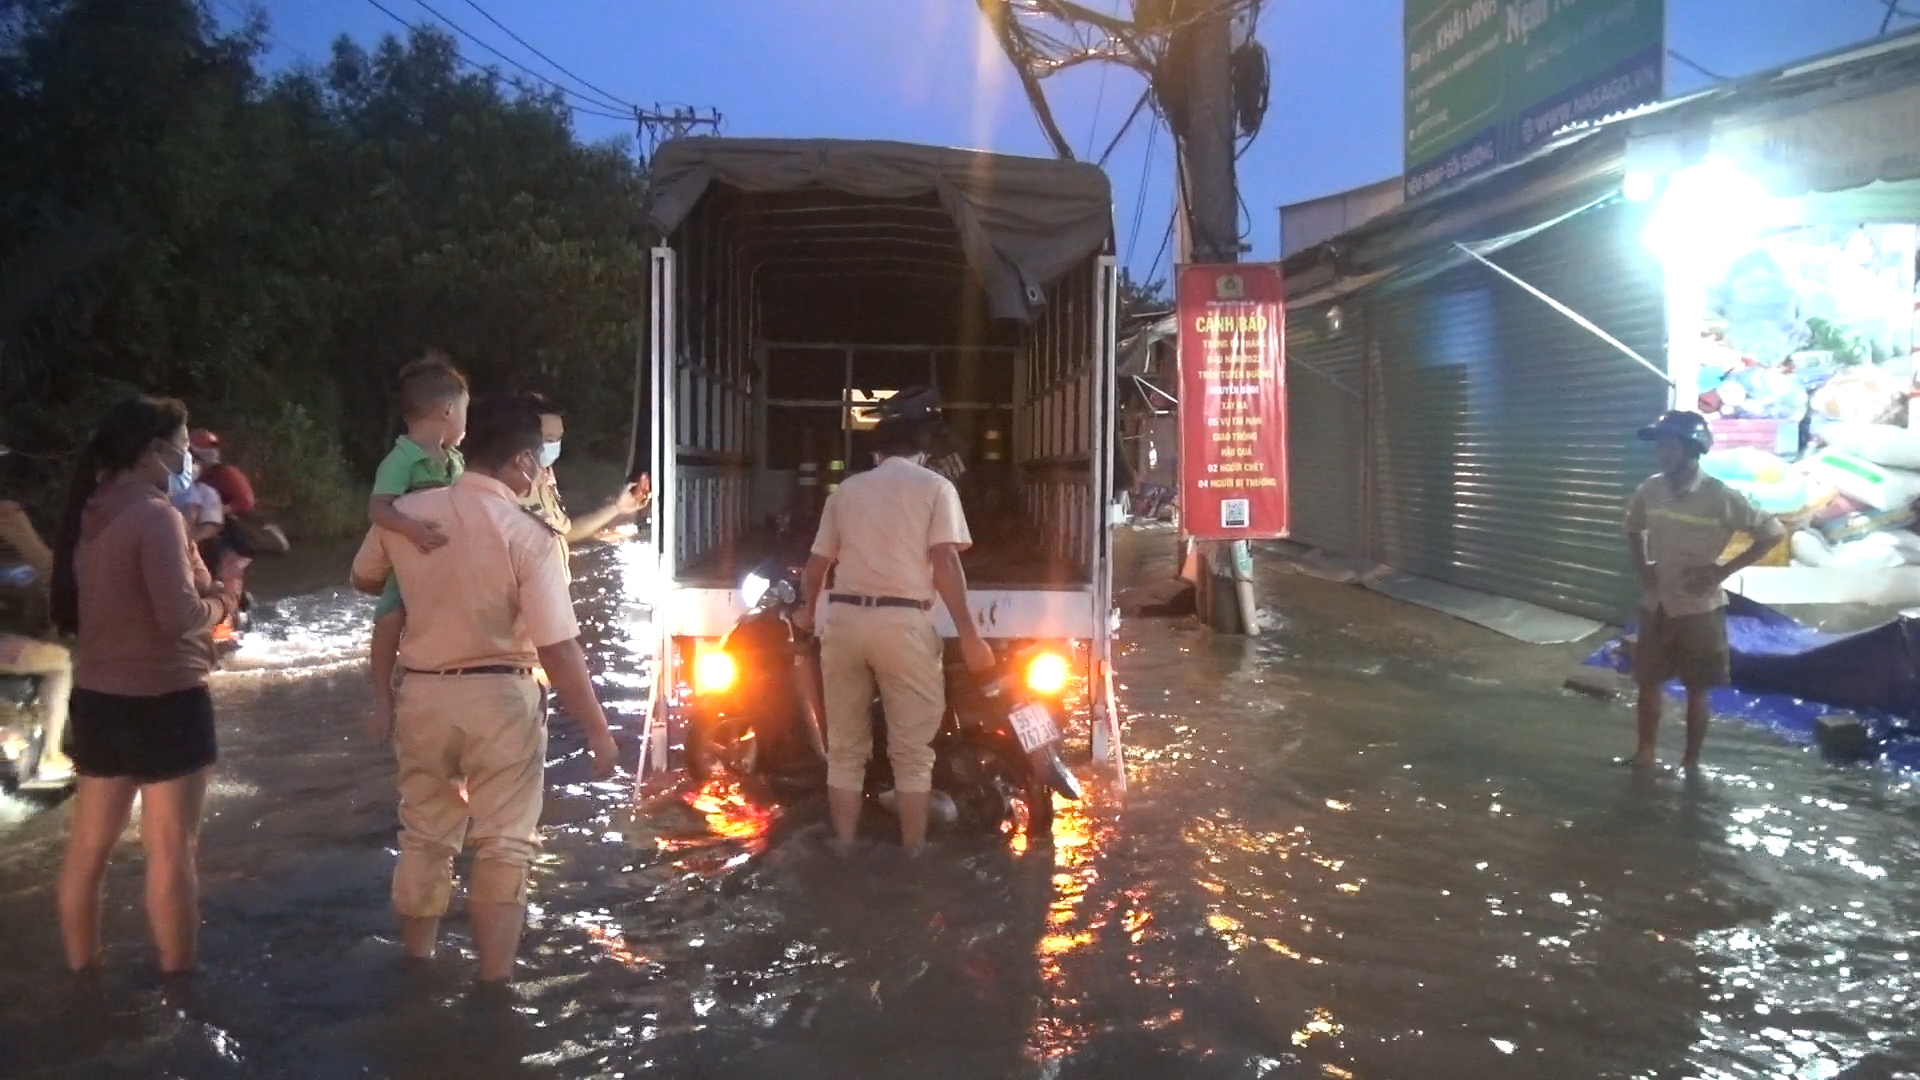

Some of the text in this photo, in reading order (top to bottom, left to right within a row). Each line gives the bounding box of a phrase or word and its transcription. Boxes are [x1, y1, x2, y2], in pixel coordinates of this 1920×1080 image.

[1195, 311, 1268, 333] CẢNH BÁO
[1207, 464, 1218, 473] 02
[1198, 479, 1208, 489] 04
